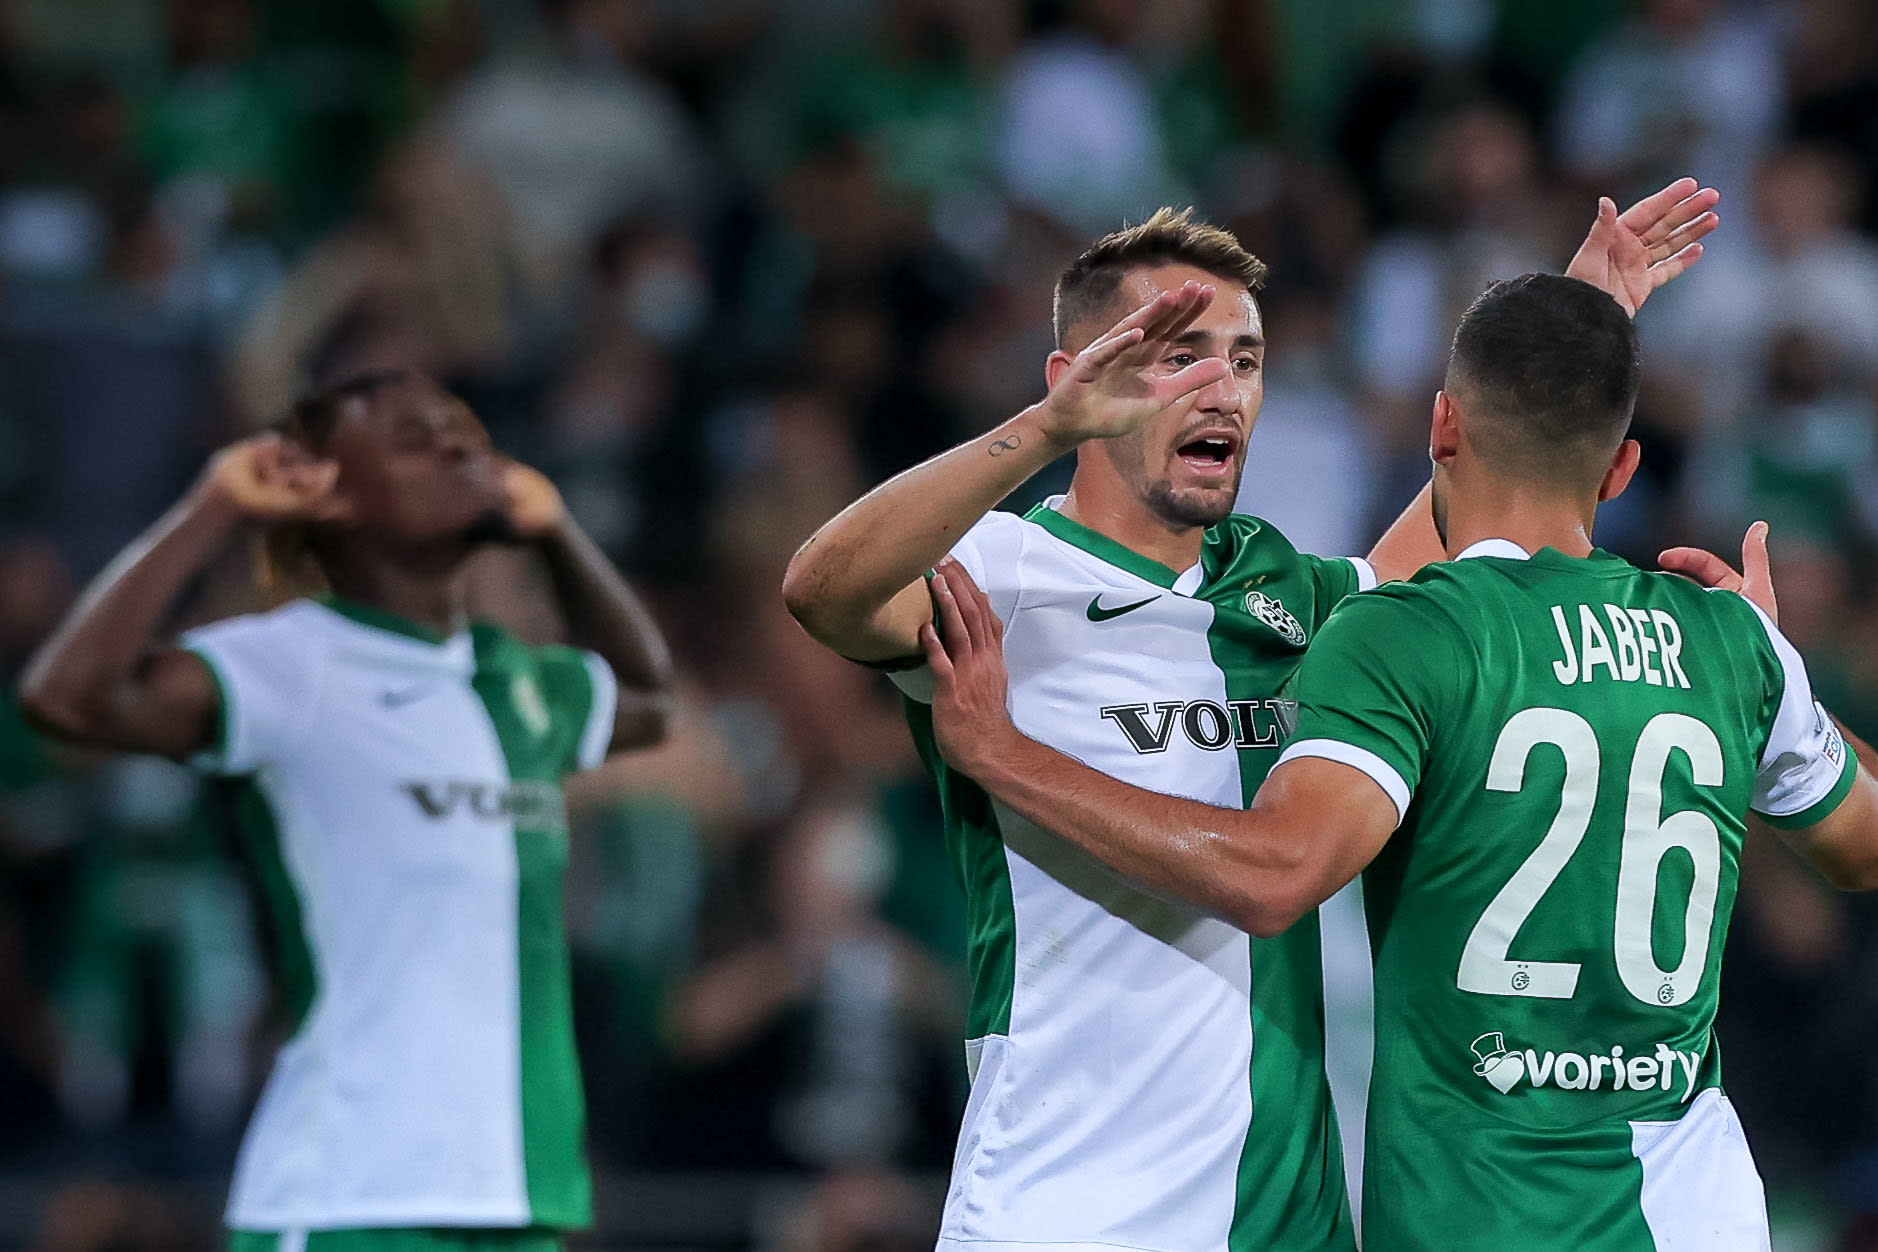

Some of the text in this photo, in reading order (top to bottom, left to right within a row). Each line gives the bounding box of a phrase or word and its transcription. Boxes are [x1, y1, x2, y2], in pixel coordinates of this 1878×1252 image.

[1549, 602, 1694, 691] JABER
[1455, 706, 1726, 1008] 26
[1524, 1043, 1701, 1104] variety
